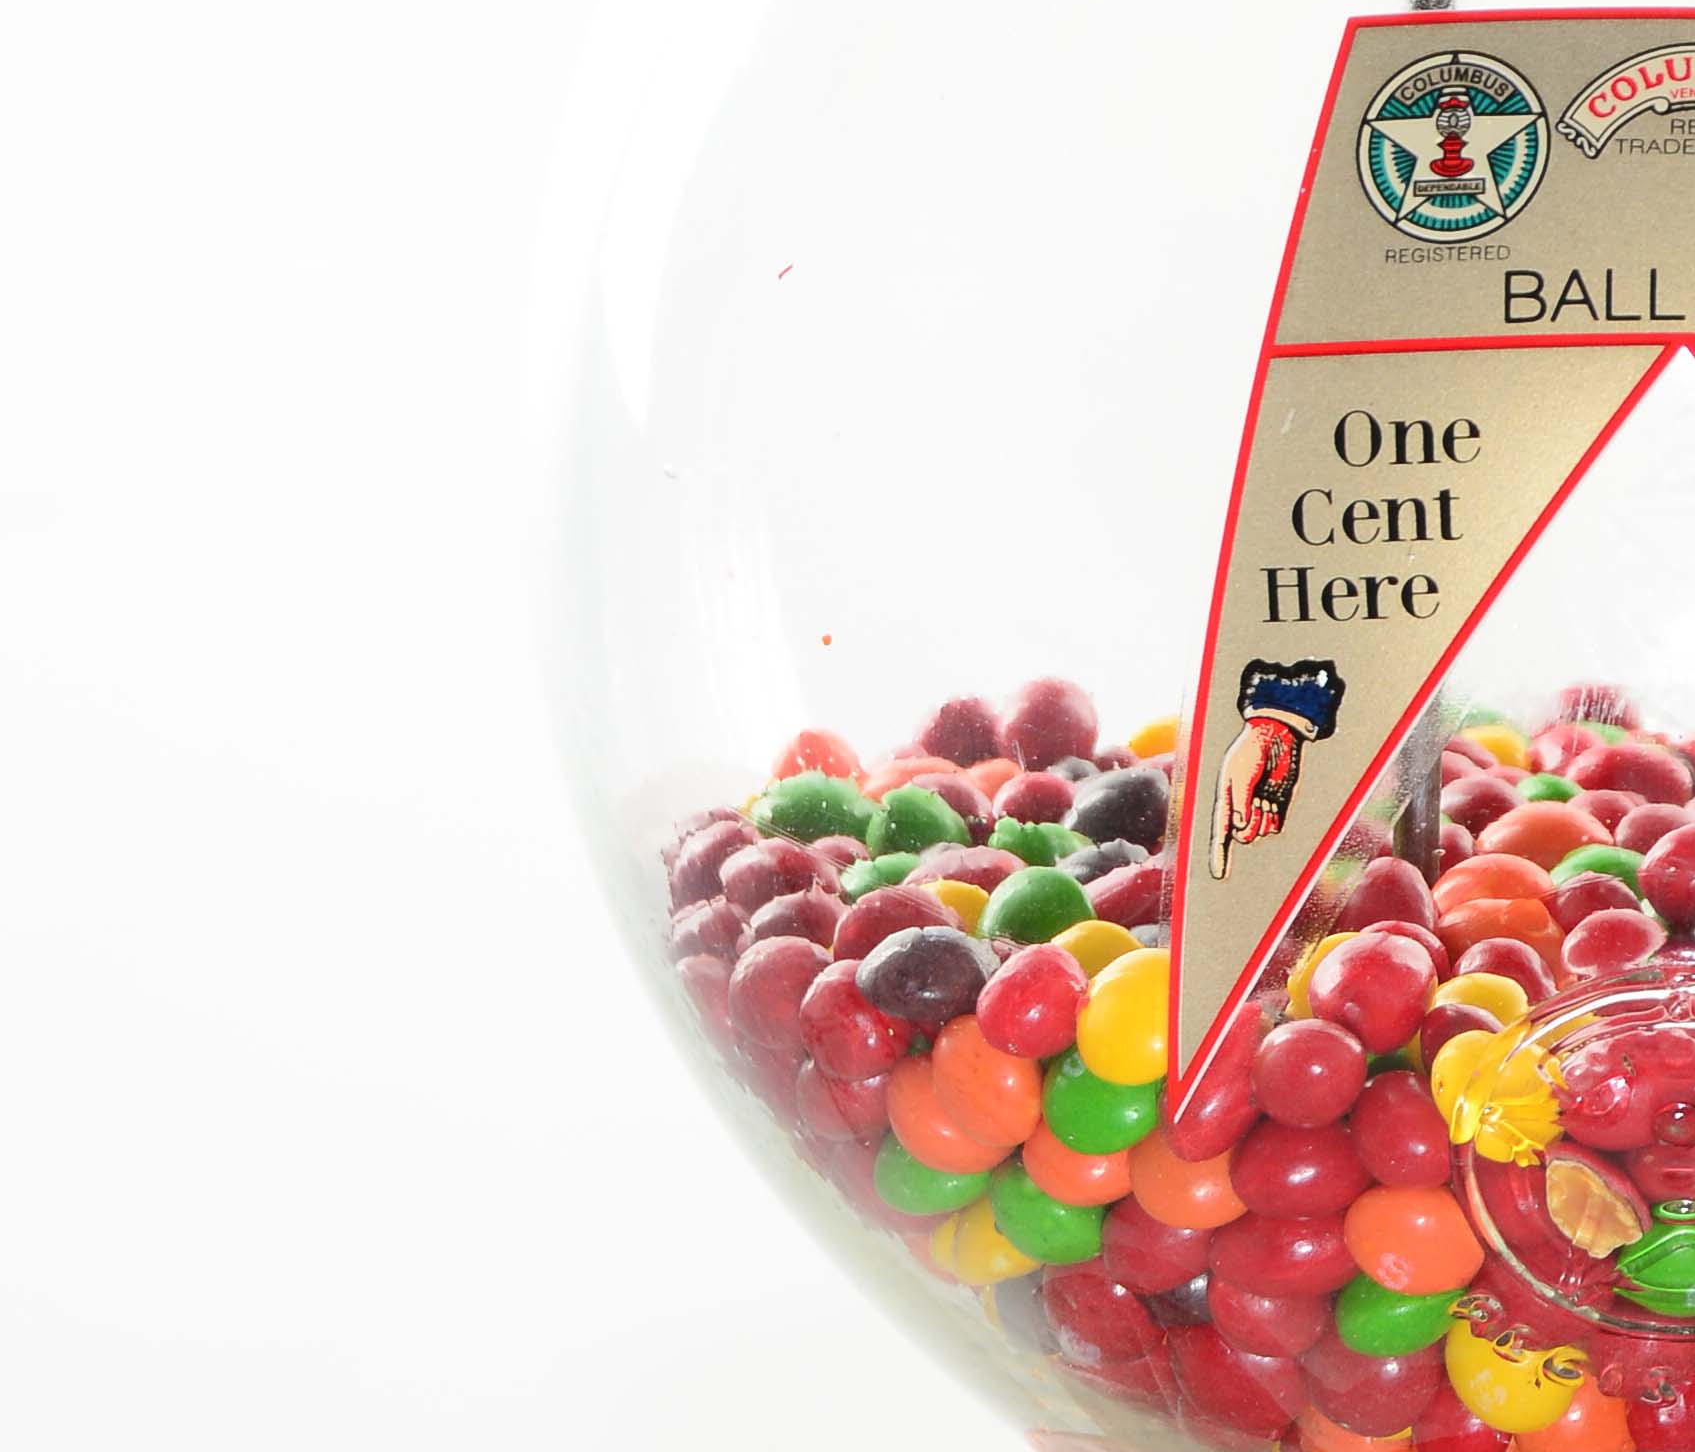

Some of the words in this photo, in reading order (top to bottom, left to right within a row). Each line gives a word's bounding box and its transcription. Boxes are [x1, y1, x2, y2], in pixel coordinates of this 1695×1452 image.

[1401, 67, 1510, 102] COLUMBUS
[1416, 181, 1482, 194] DEPENDABLE
[1384, 245, 1511, 264] REGISTERED
[1504, 268, 1686, 324] BALL
[1333, 409, 1482, 467] One
[1291, 488, 1463, 546] Cent
[1259, 566, 1441, 623] Here
